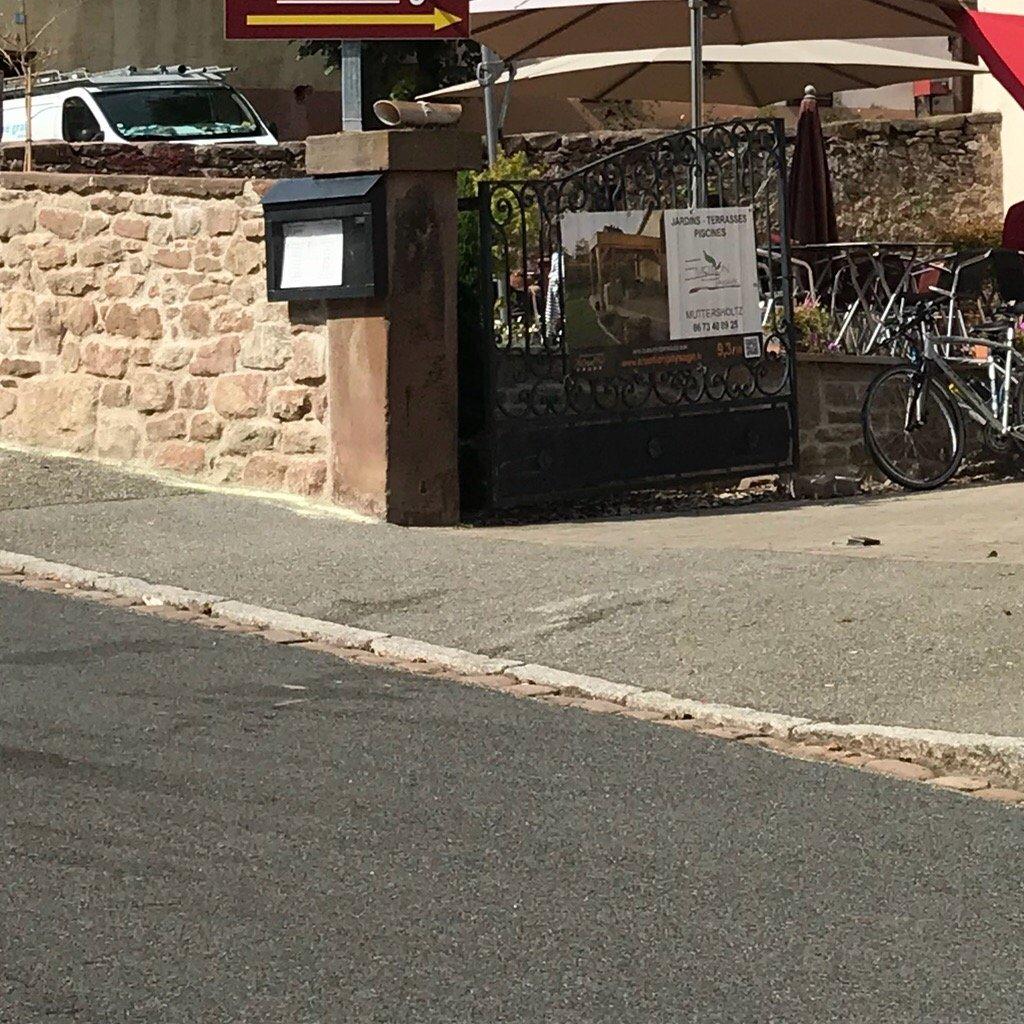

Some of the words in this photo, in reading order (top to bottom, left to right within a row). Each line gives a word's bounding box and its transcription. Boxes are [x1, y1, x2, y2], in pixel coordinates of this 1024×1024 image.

[671, 216, 701, 226] JARDINS
[706, 214, 747, 224] TERRASSES
[694, 228, 727, 238] PISCINES
[685, 306, 743, 318] MUTTERSHOLTZ
